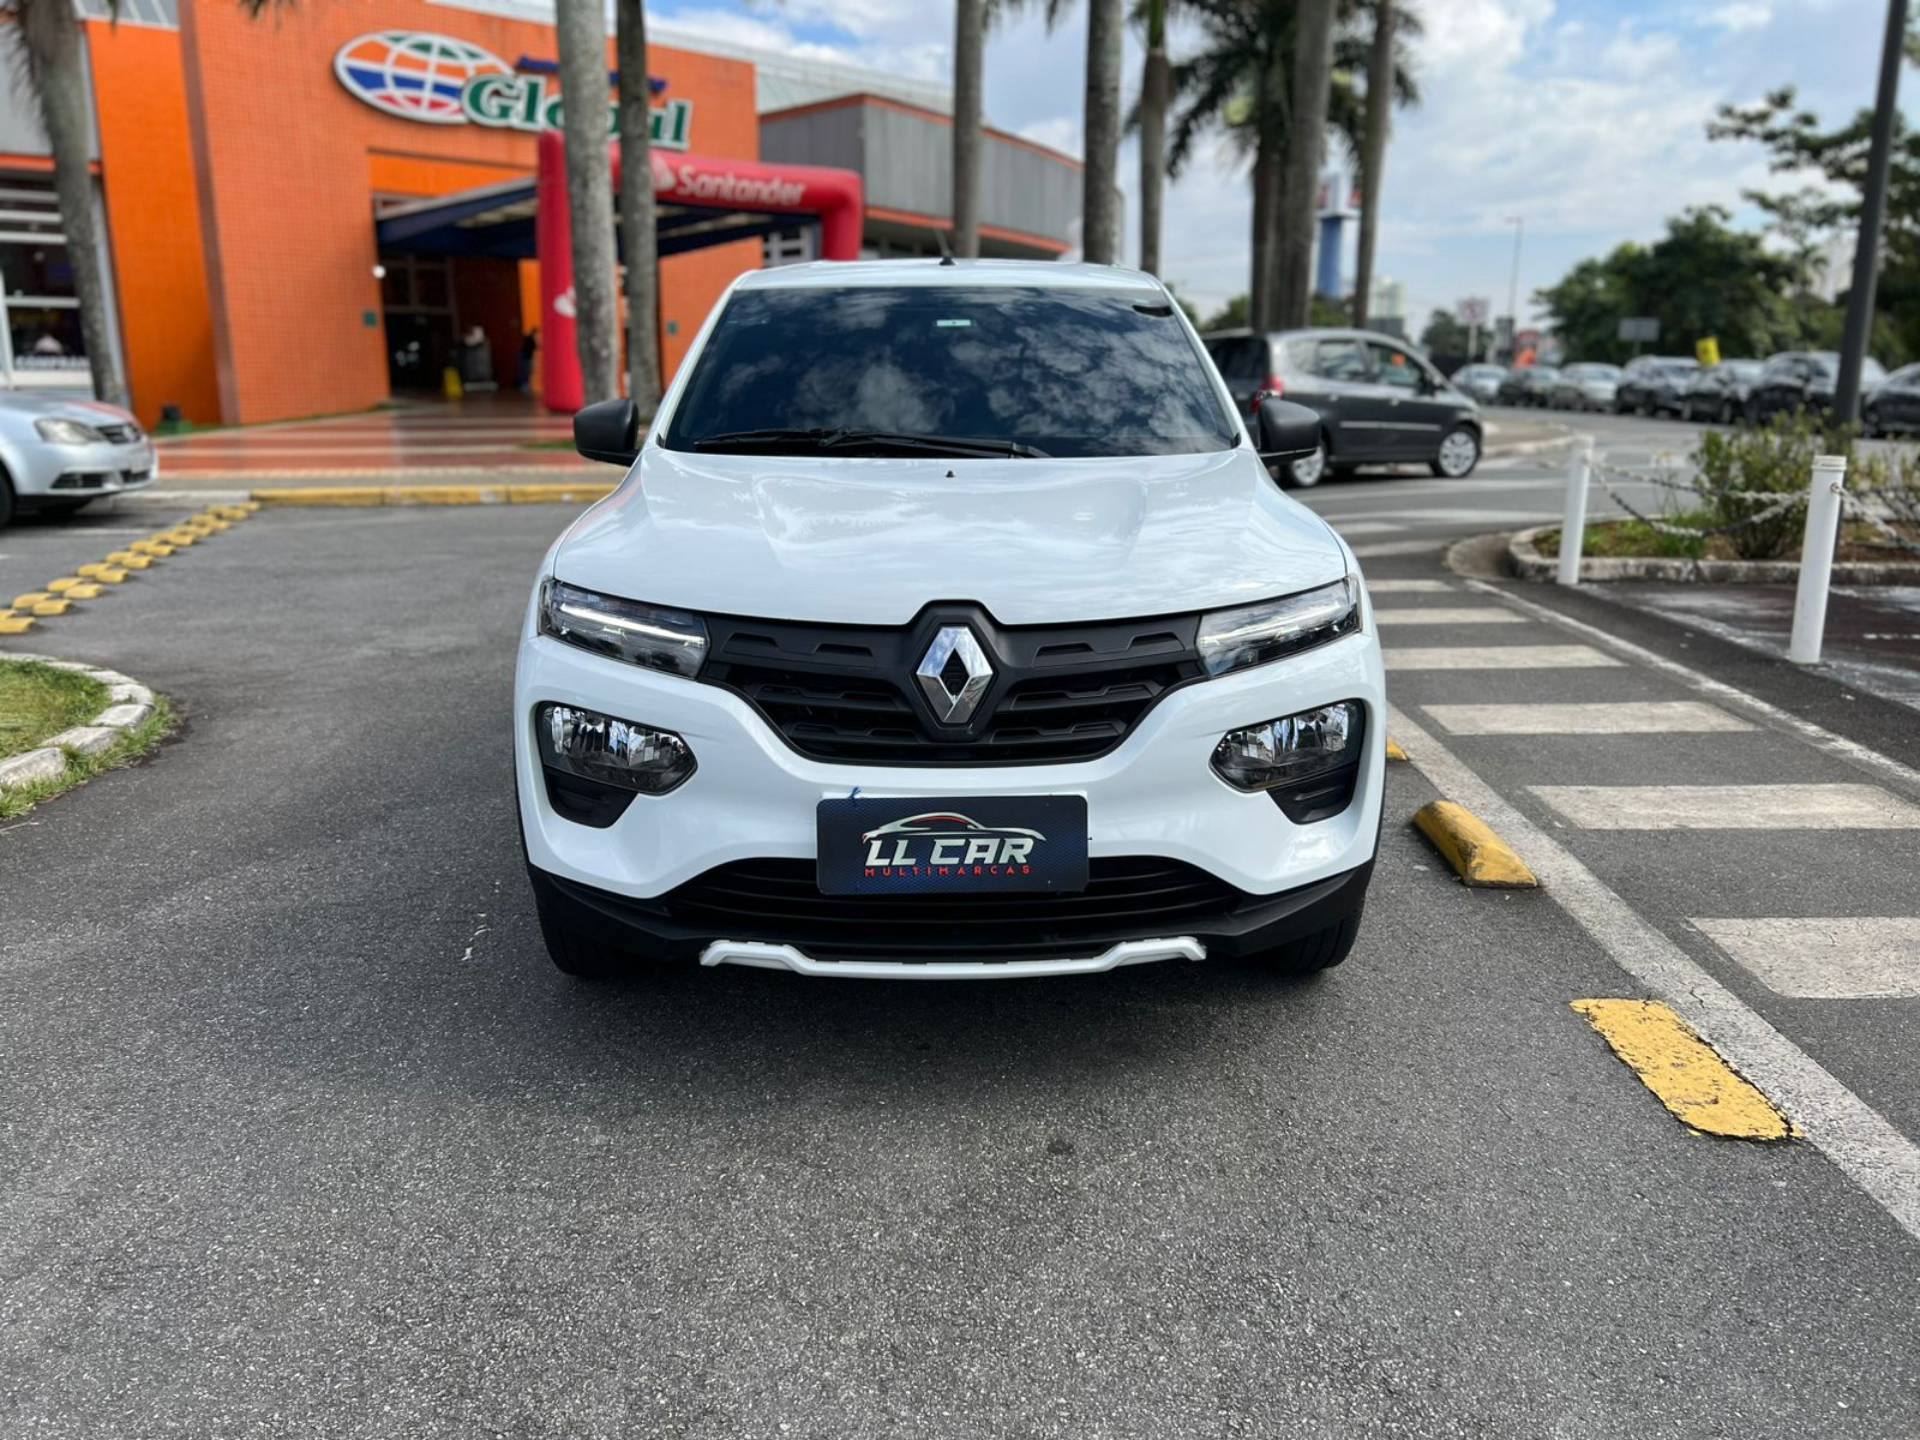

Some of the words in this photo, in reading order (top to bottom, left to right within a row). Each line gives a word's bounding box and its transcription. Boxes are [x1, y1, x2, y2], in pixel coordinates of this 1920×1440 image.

[677, 164, 807, 206] Santander
[865, 839, 917, 866] LL
[930, 838, 1034, 865] CAR
[864, 865, 1032, 877] MULTIMARCAS
